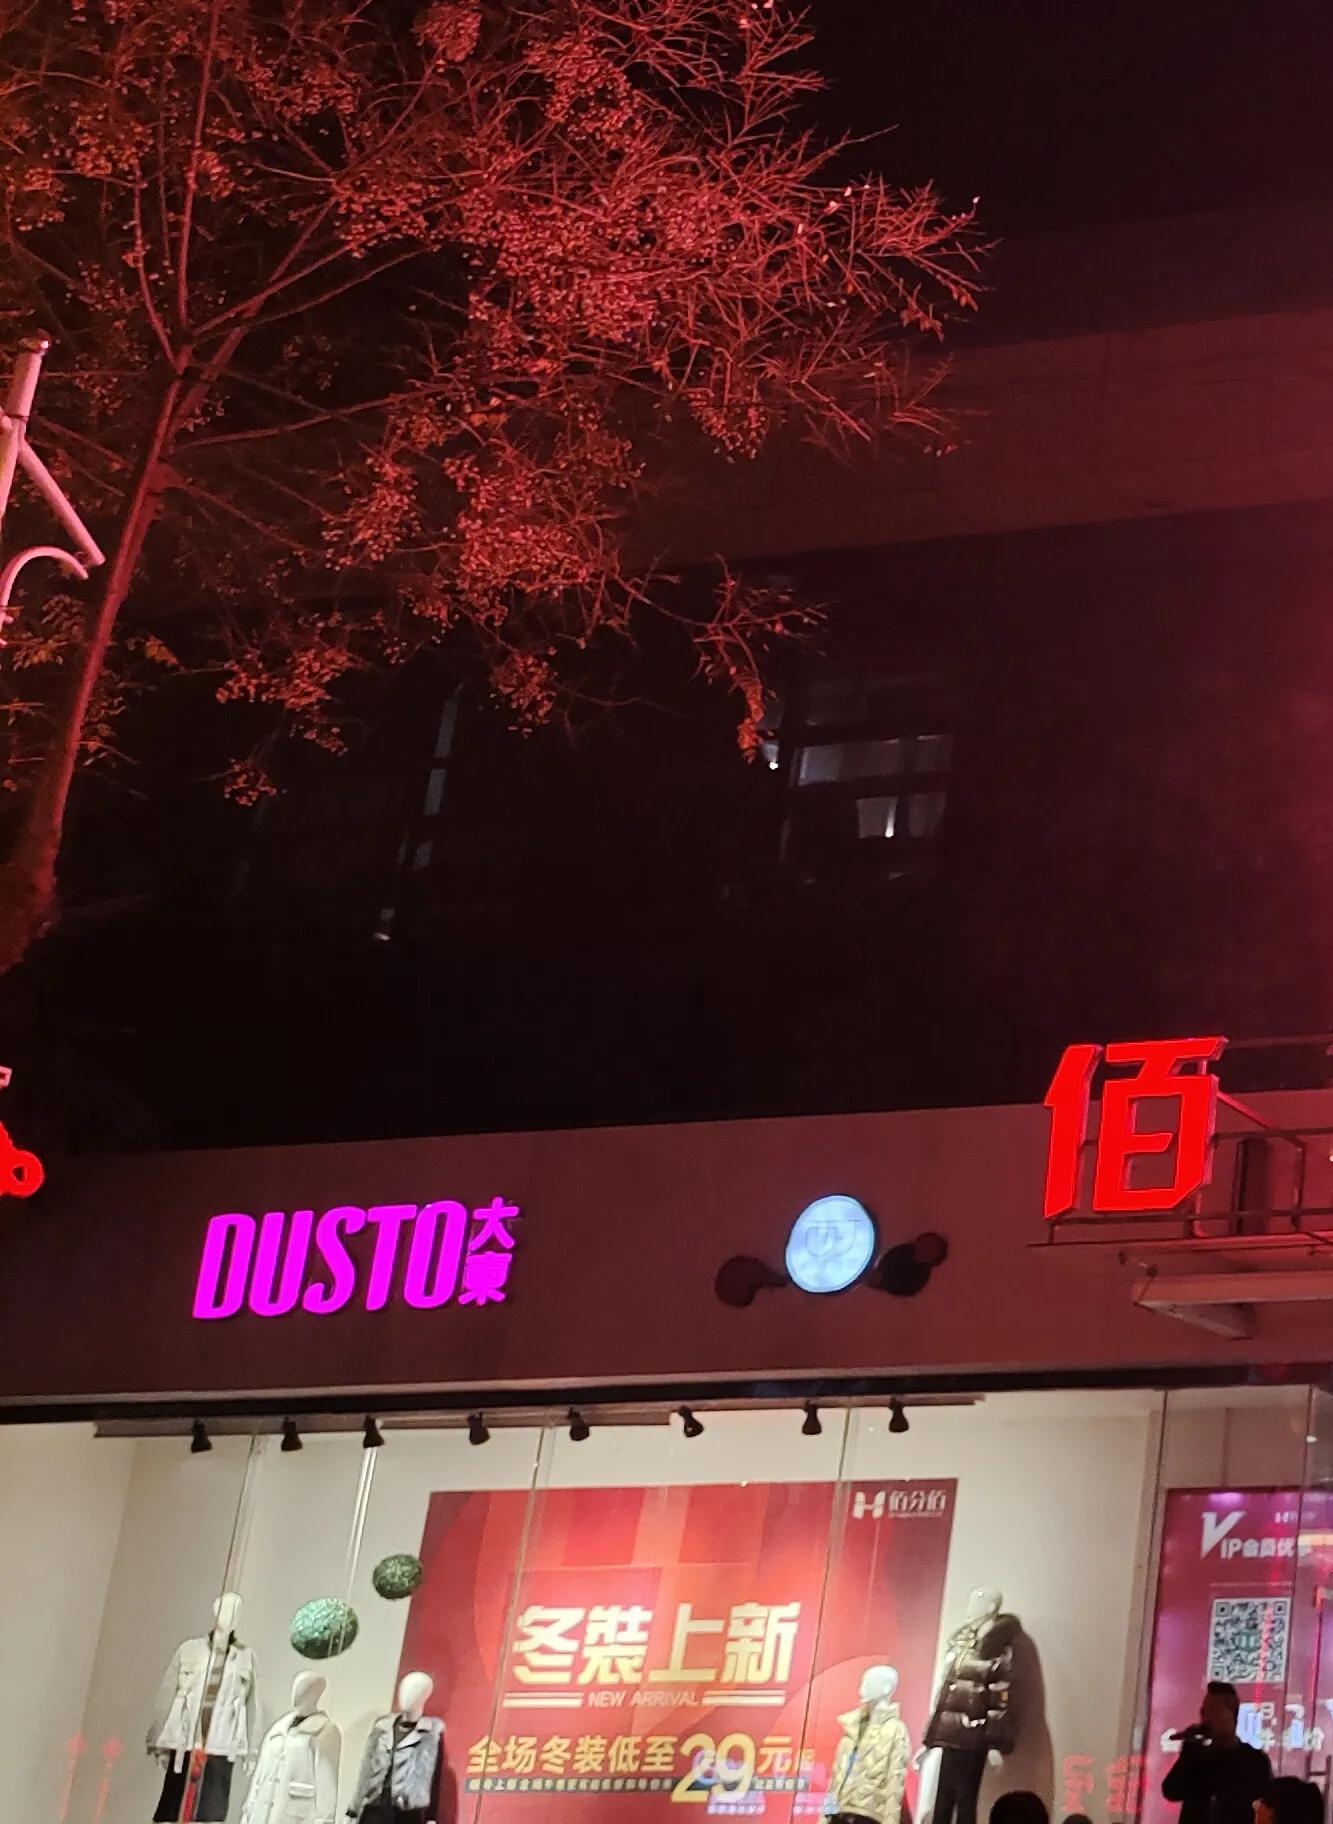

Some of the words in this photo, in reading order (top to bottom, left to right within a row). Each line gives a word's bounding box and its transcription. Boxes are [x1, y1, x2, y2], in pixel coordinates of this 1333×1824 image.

[192, 1200, 467, 1319] DUSTO
[588, 1690, 626, 1707] NEW
[630, 1689, 698, 1707] ARRIVAL
